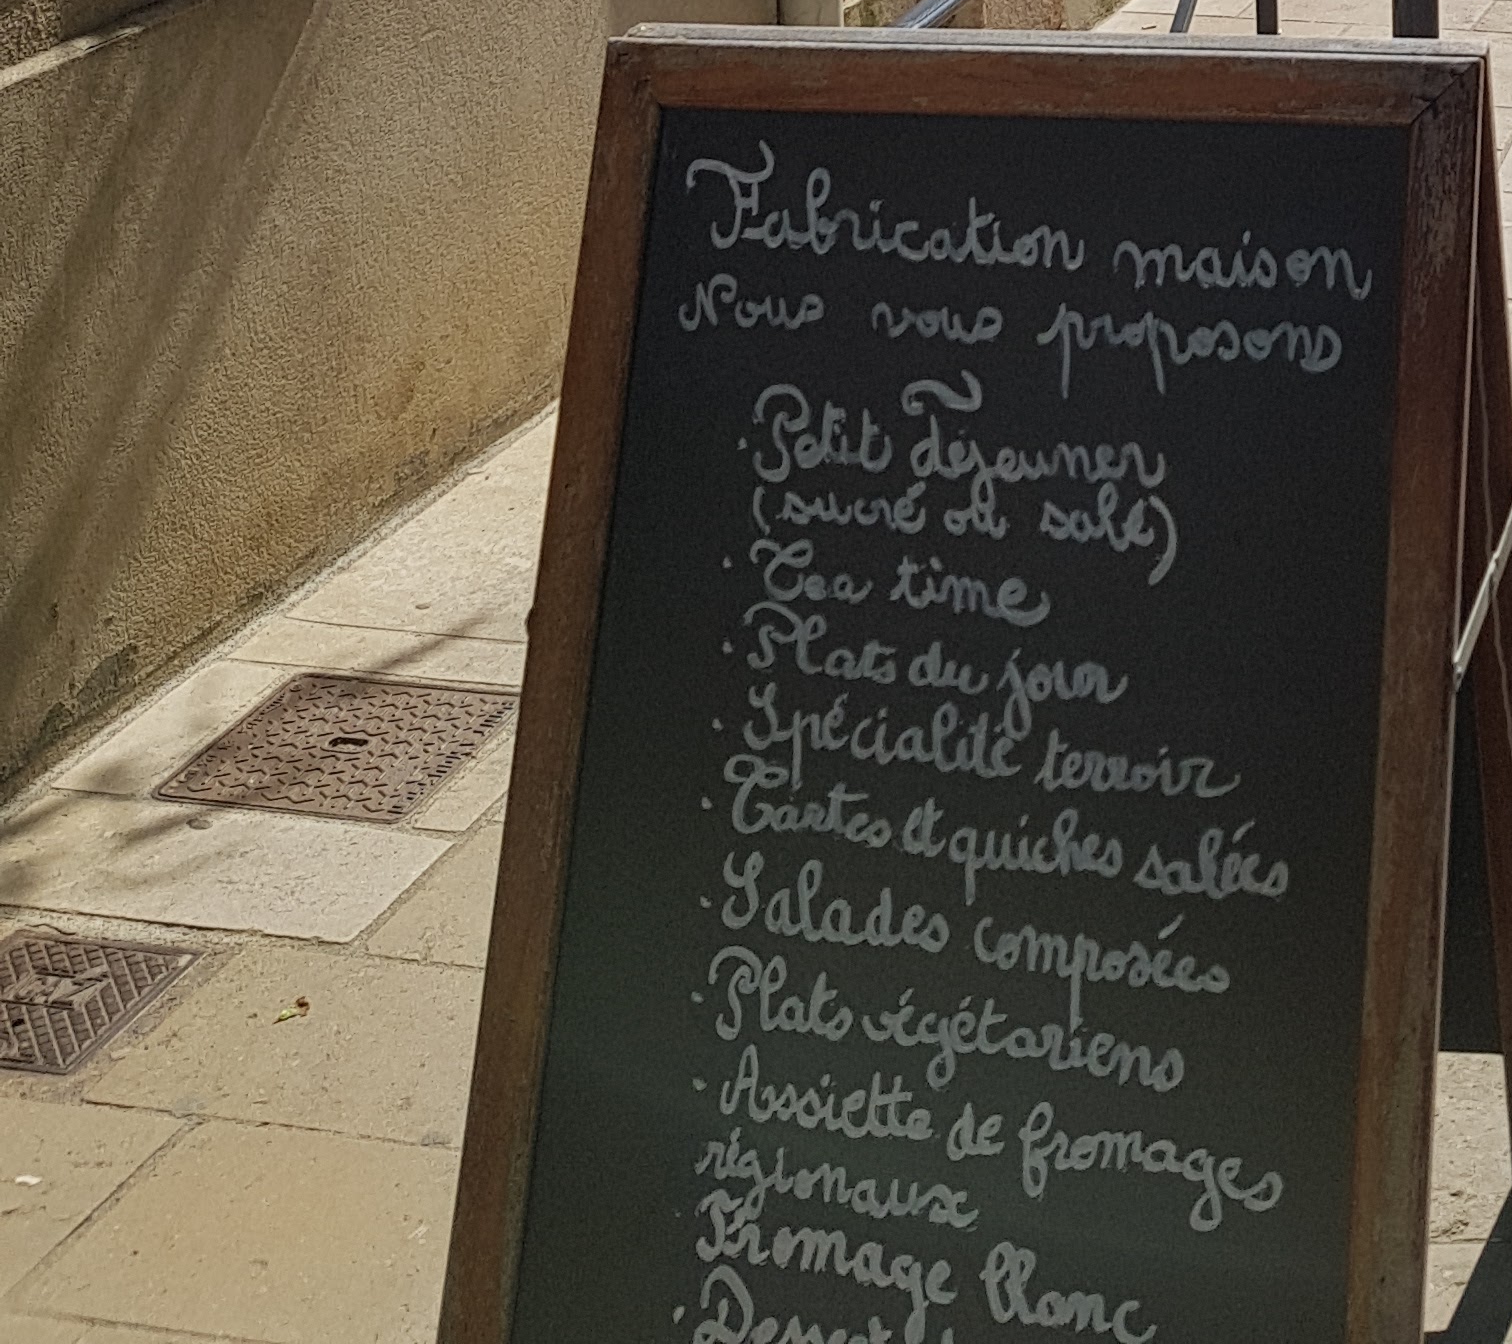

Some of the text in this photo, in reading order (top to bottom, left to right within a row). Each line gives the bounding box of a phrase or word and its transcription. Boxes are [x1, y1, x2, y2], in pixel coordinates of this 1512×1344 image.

[685, 138, 1373, 301] Fabrication maison
[678, 272, 1343, 400] Nous vous proposons
[752, 383, 1166, 513] Petit déjeuner
[748, 537, 1052, 628] Tea time
[943, 502, 1010, 541] ou
[741, 681, 1242, 799] Spécialité terroir
[742, 599, 1129, 741] Plats du jour
[722, 752, 1289, 906] Tartes et quiches salées
[720, 848, 1232, 1030] Salades composées
[706, 944, 1186, 1092] Plats végétariens
[694, 1125, 980, 1230] régionaux
[719, 1042, 1284, 1232] Assiette de fromages
[695, 1188, 958, 1344] Fromage
